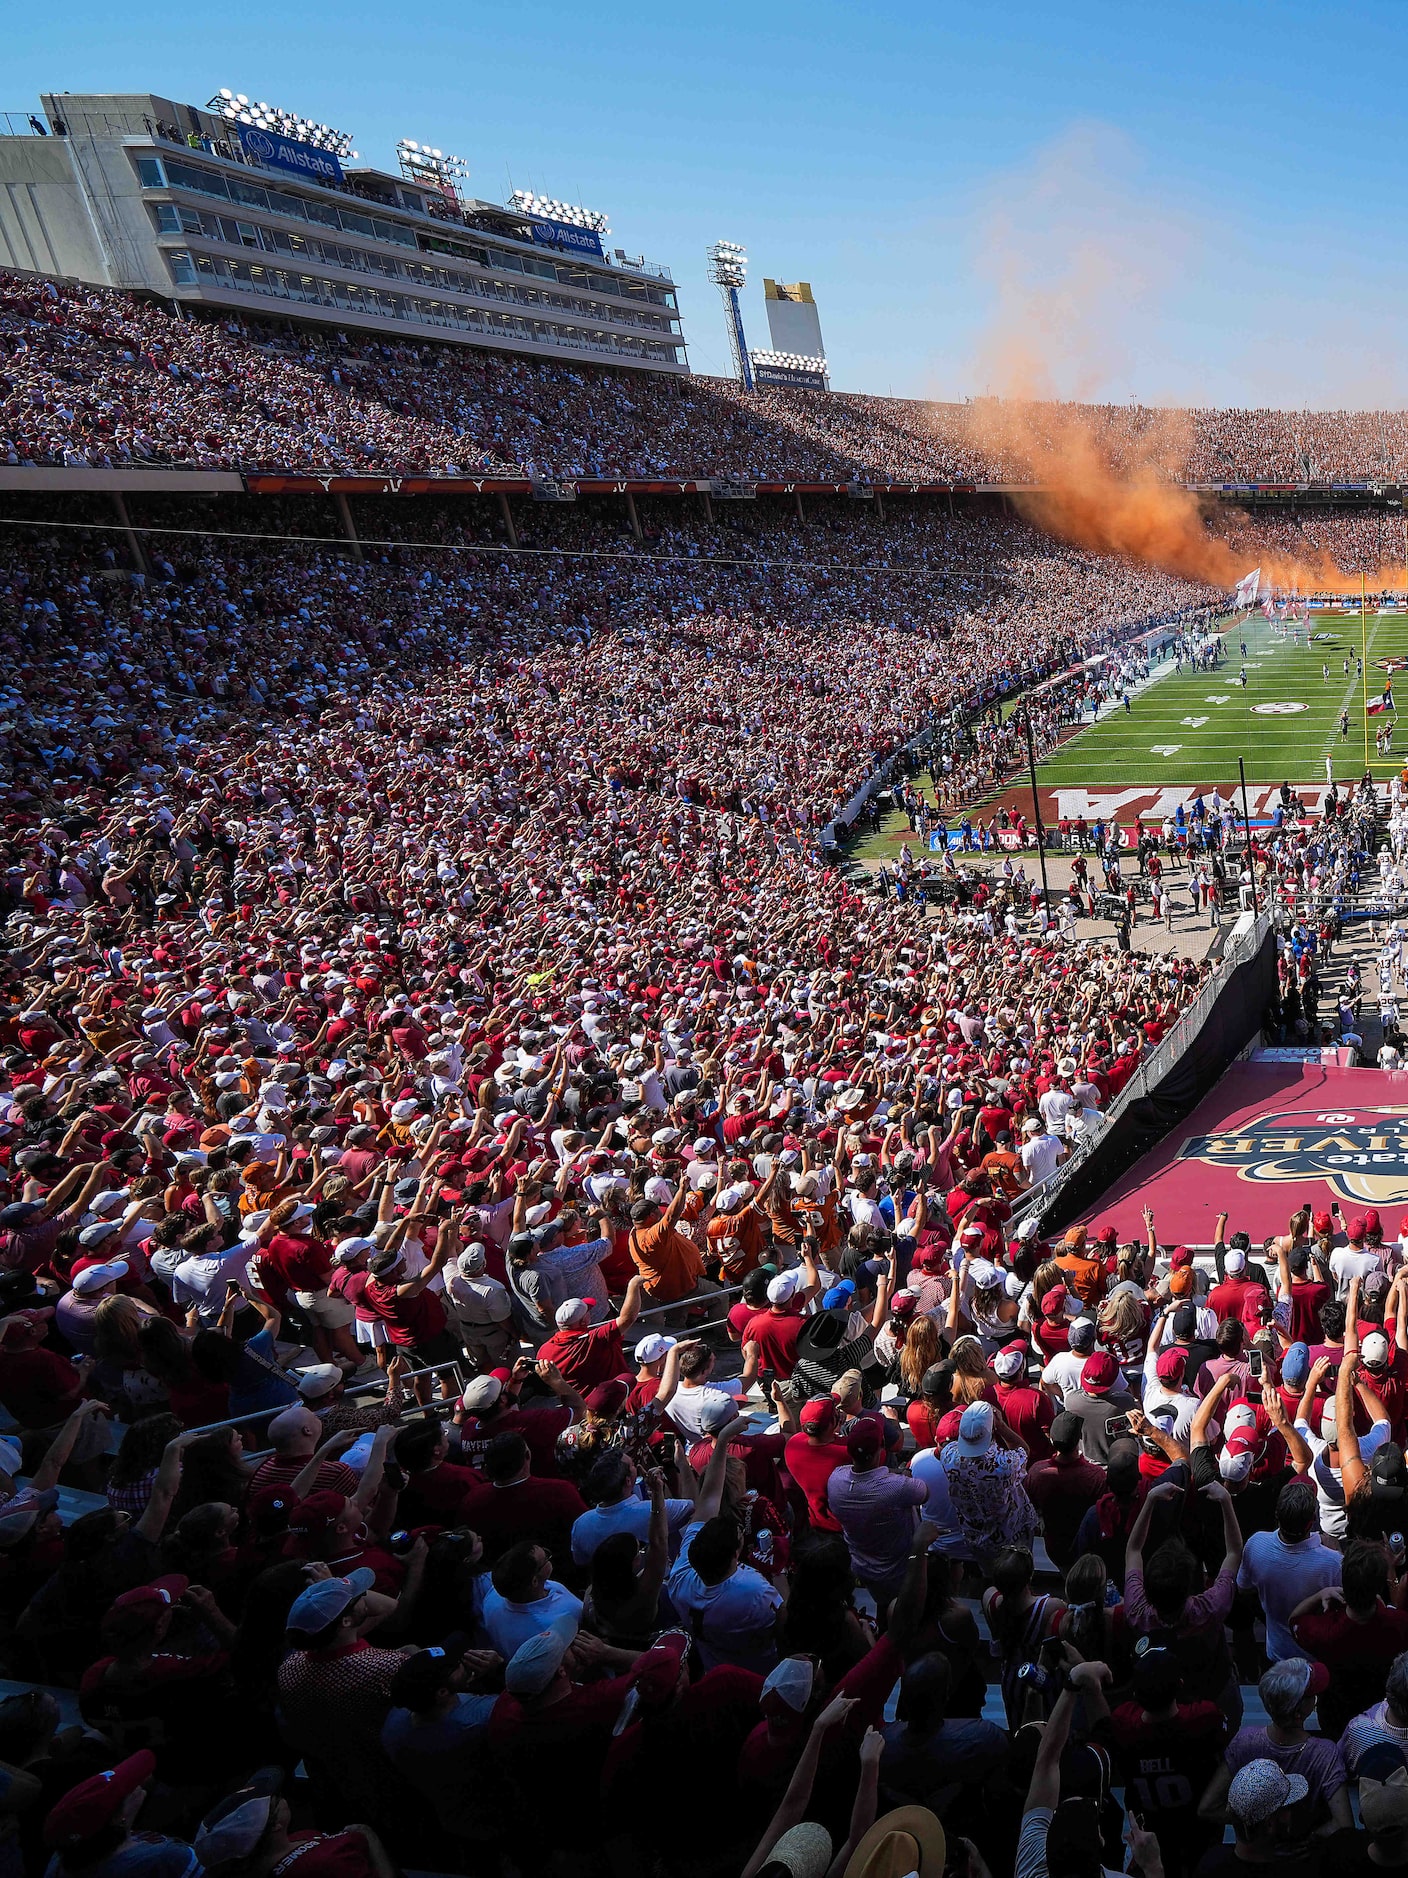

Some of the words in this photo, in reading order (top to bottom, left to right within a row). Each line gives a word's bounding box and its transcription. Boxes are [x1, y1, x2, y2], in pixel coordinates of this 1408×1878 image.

[278, 144, 335, 176] Allstate
[557, 229, 597, 248] Allstate
[1381, 959, 1391, 969] 13
[1263, 1048, 1337, 1056] HORNS
[1315, 1113, 1356, 1124] OU
[462, 1439, 491, 1450] MAYFIE
[1140, 1758, 1174, 1774] BELL
[1133, 1774, 1194, 1811] 10
